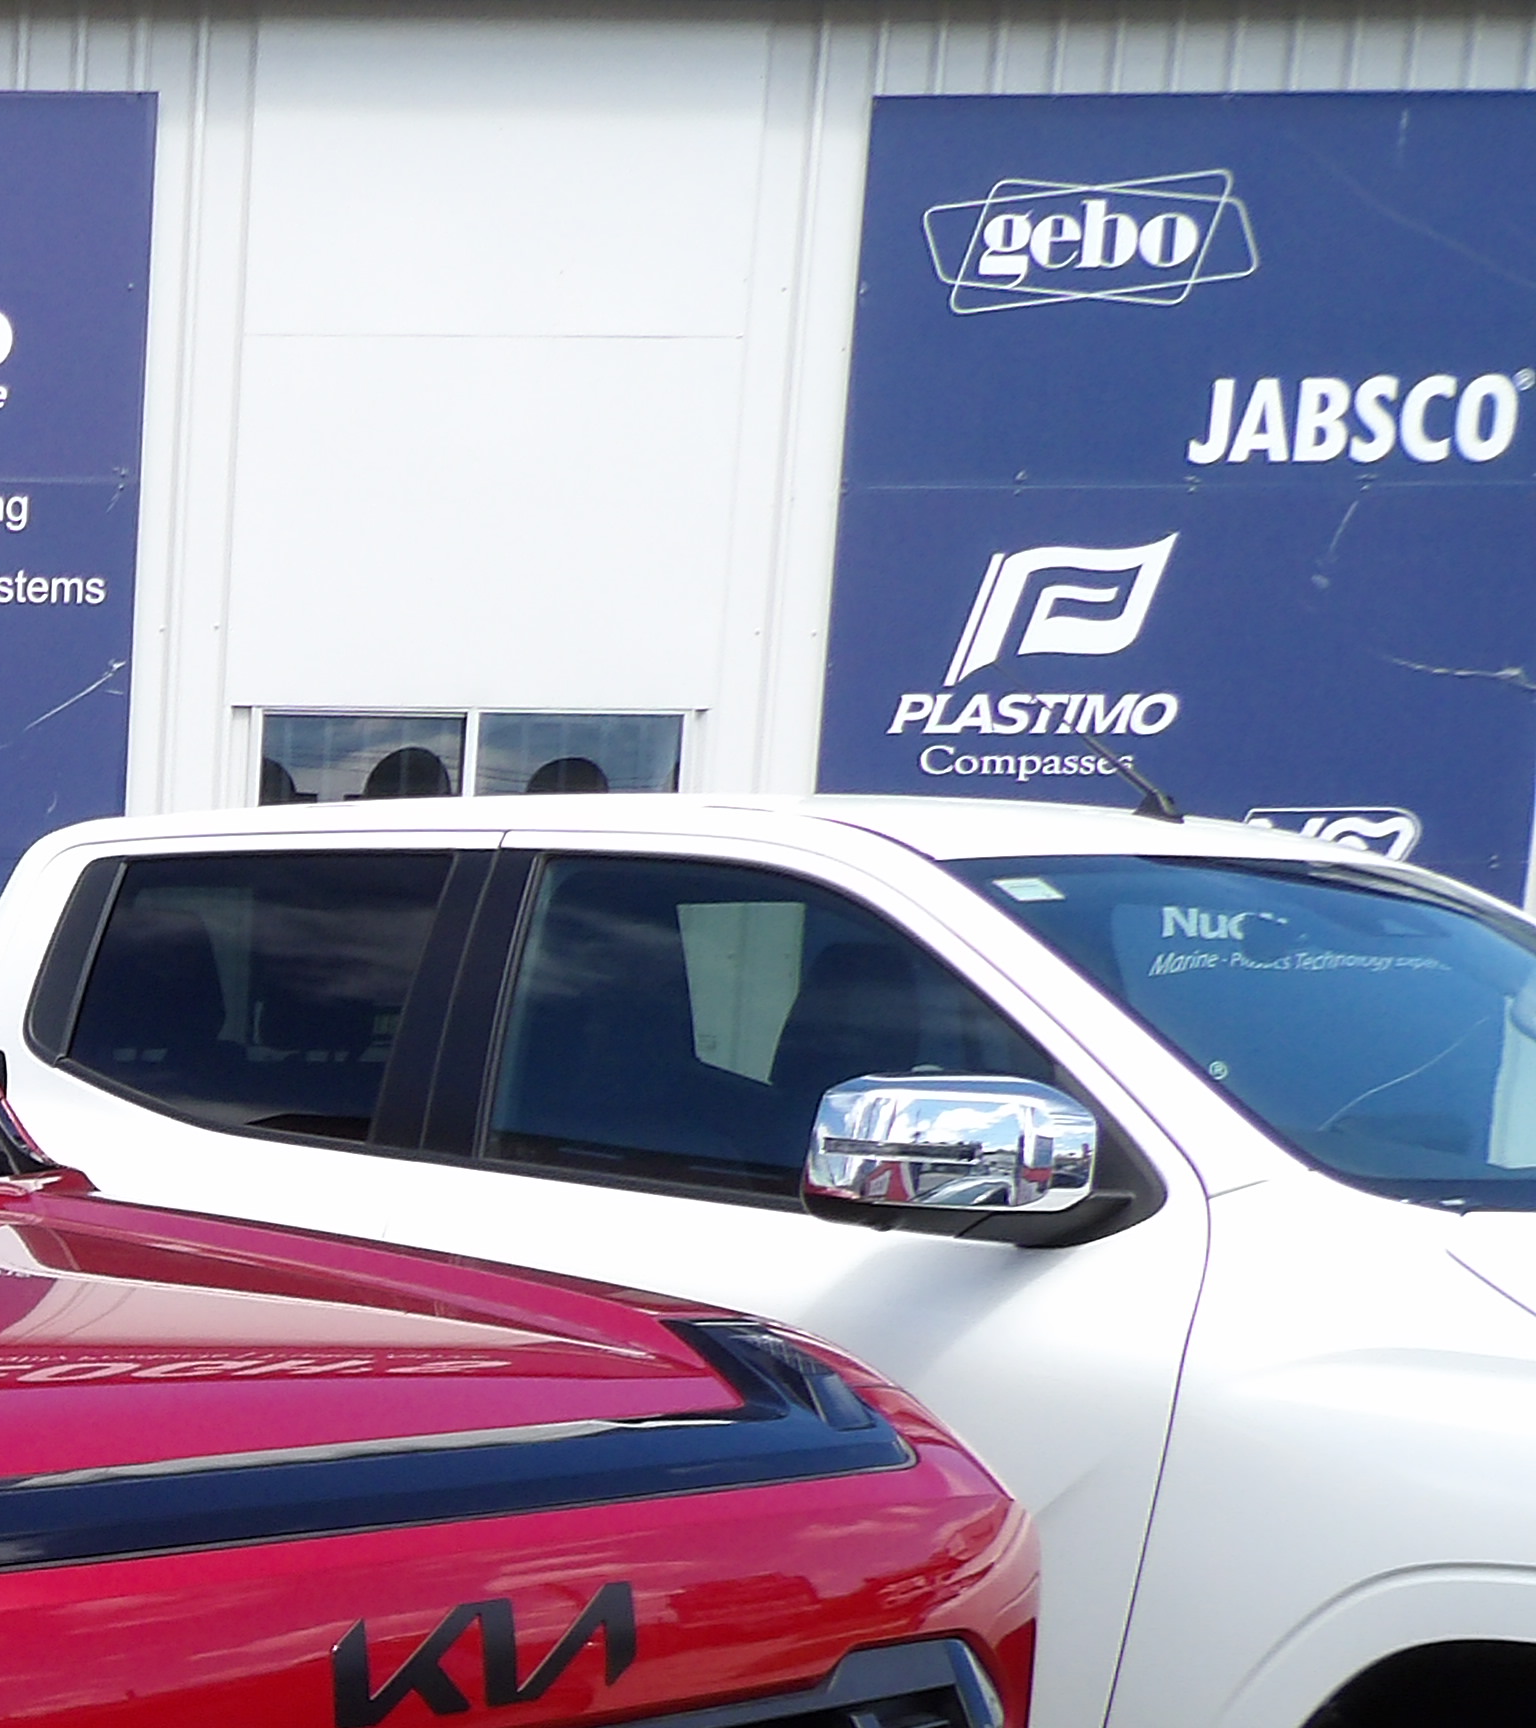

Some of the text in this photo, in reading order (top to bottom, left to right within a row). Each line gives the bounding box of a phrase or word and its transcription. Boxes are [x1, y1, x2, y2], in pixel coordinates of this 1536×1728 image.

[978, 200, 1199, 289] gebo
[1186, 374, 1519, 465] JABSCO
[886, 693, 1180, 735] PLASTIMO
